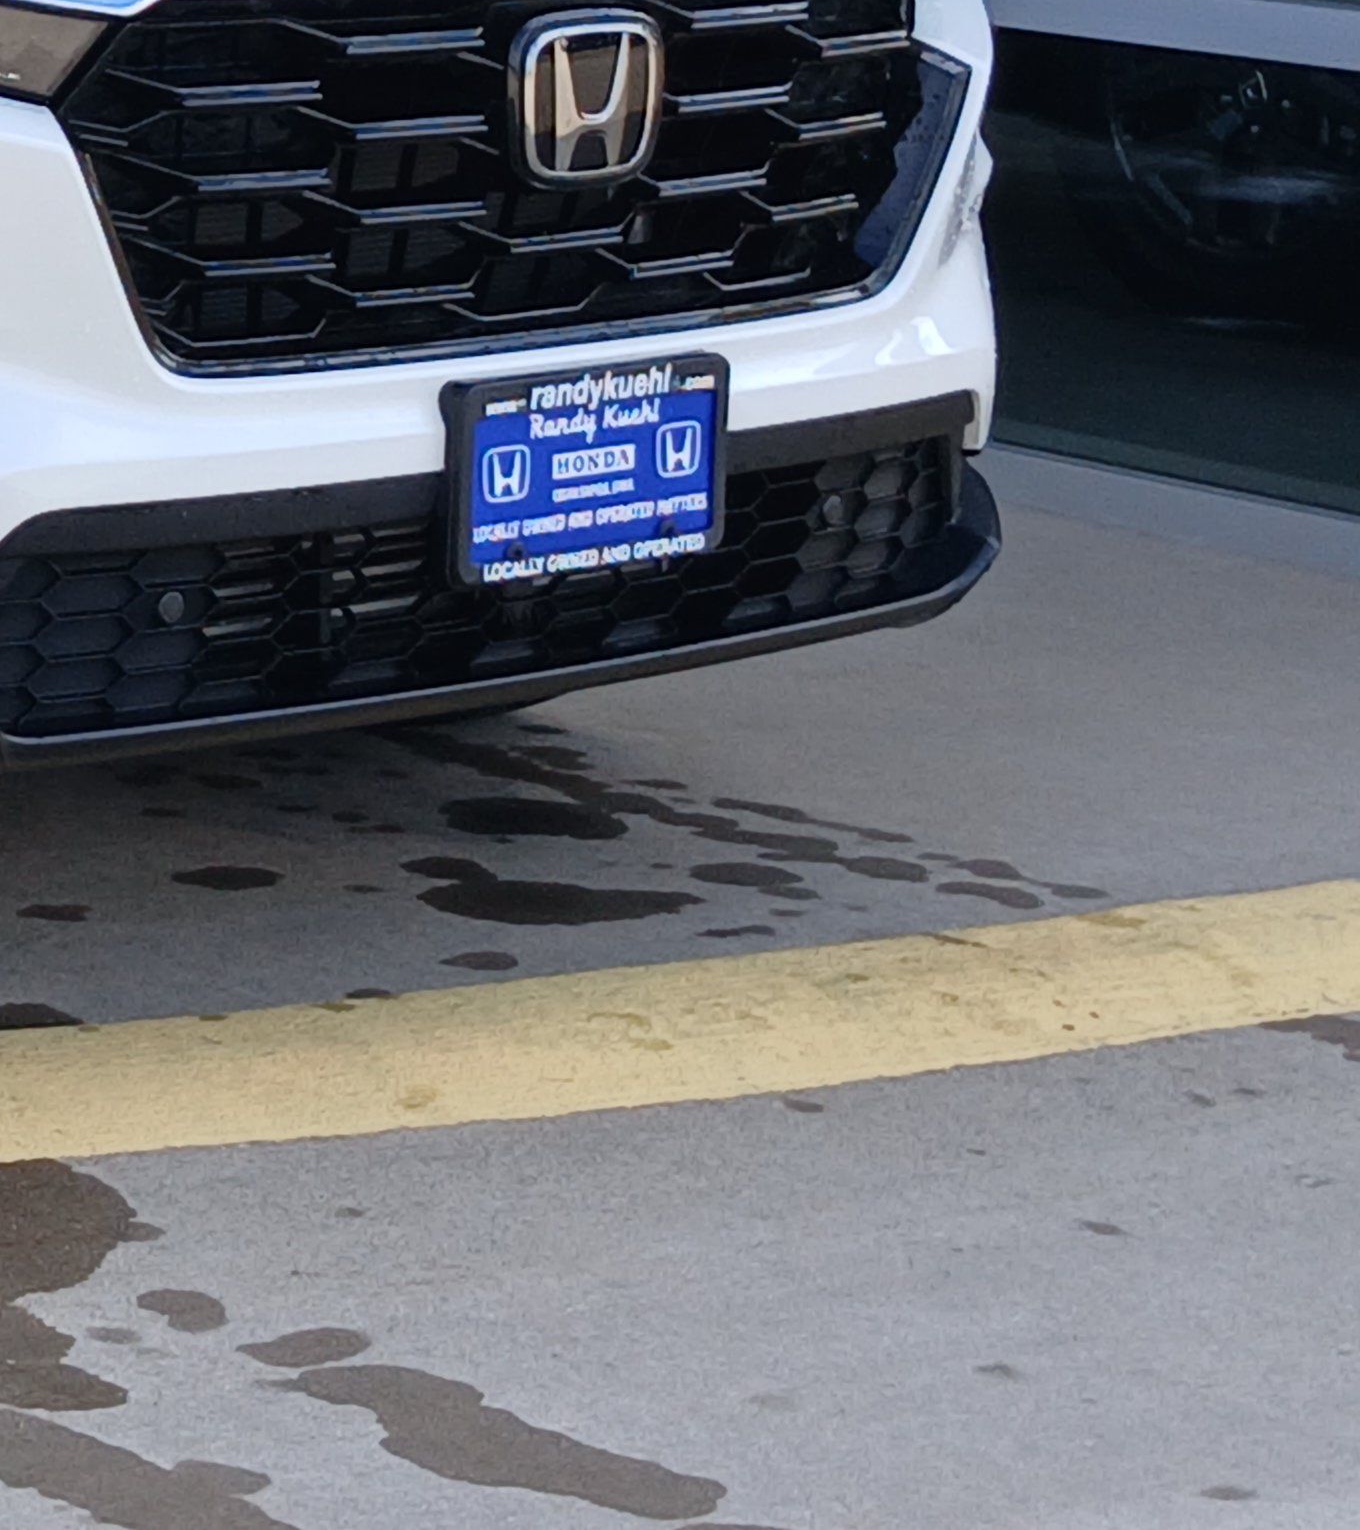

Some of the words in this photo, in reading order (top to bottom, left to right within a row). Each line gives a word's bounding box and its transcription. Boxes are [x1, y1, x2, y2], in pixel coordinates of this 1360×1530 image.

[529, 362, 672, 410] randykuehl
[529, 407, 596, 445] Randy
[602, 398, 662, 429] Kuehl
[555, 447, 630, 476] HONDA
[483, 556, 546, 583] LOCALLY
[547, 549, 600, 573] OWNED
[600, 545, 631, 566] AND
[634, 533, 706, 560] OPERATED
